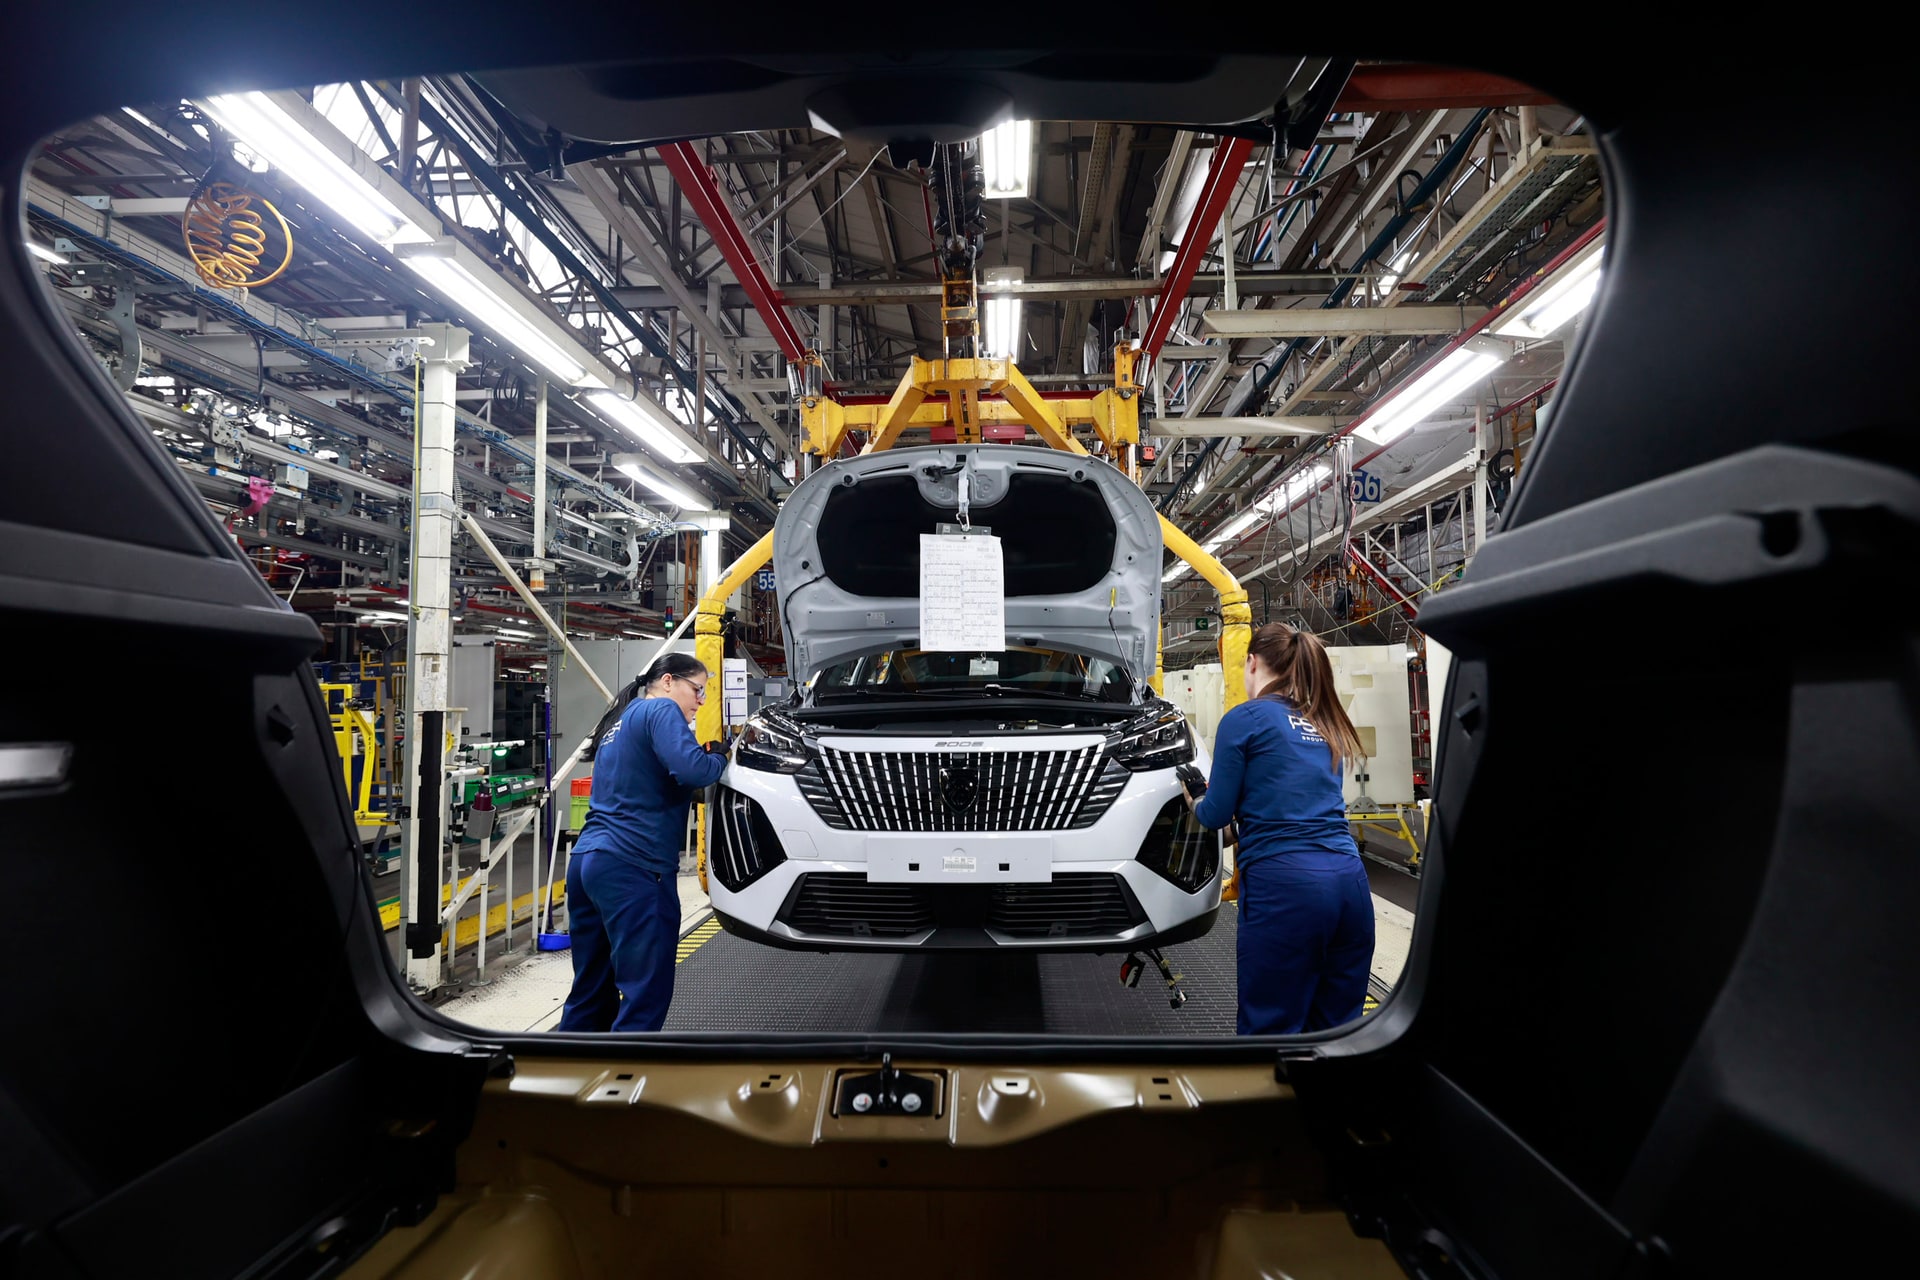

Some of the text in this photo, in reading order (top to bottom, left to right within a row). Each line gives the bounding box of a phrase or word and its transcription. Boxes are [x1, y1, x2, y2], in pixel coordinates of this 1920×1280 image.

[1350, 471, 1379, 500] 56
[759, 572, 776, 589] 55
[1287, 714, 1317, 732] PS
